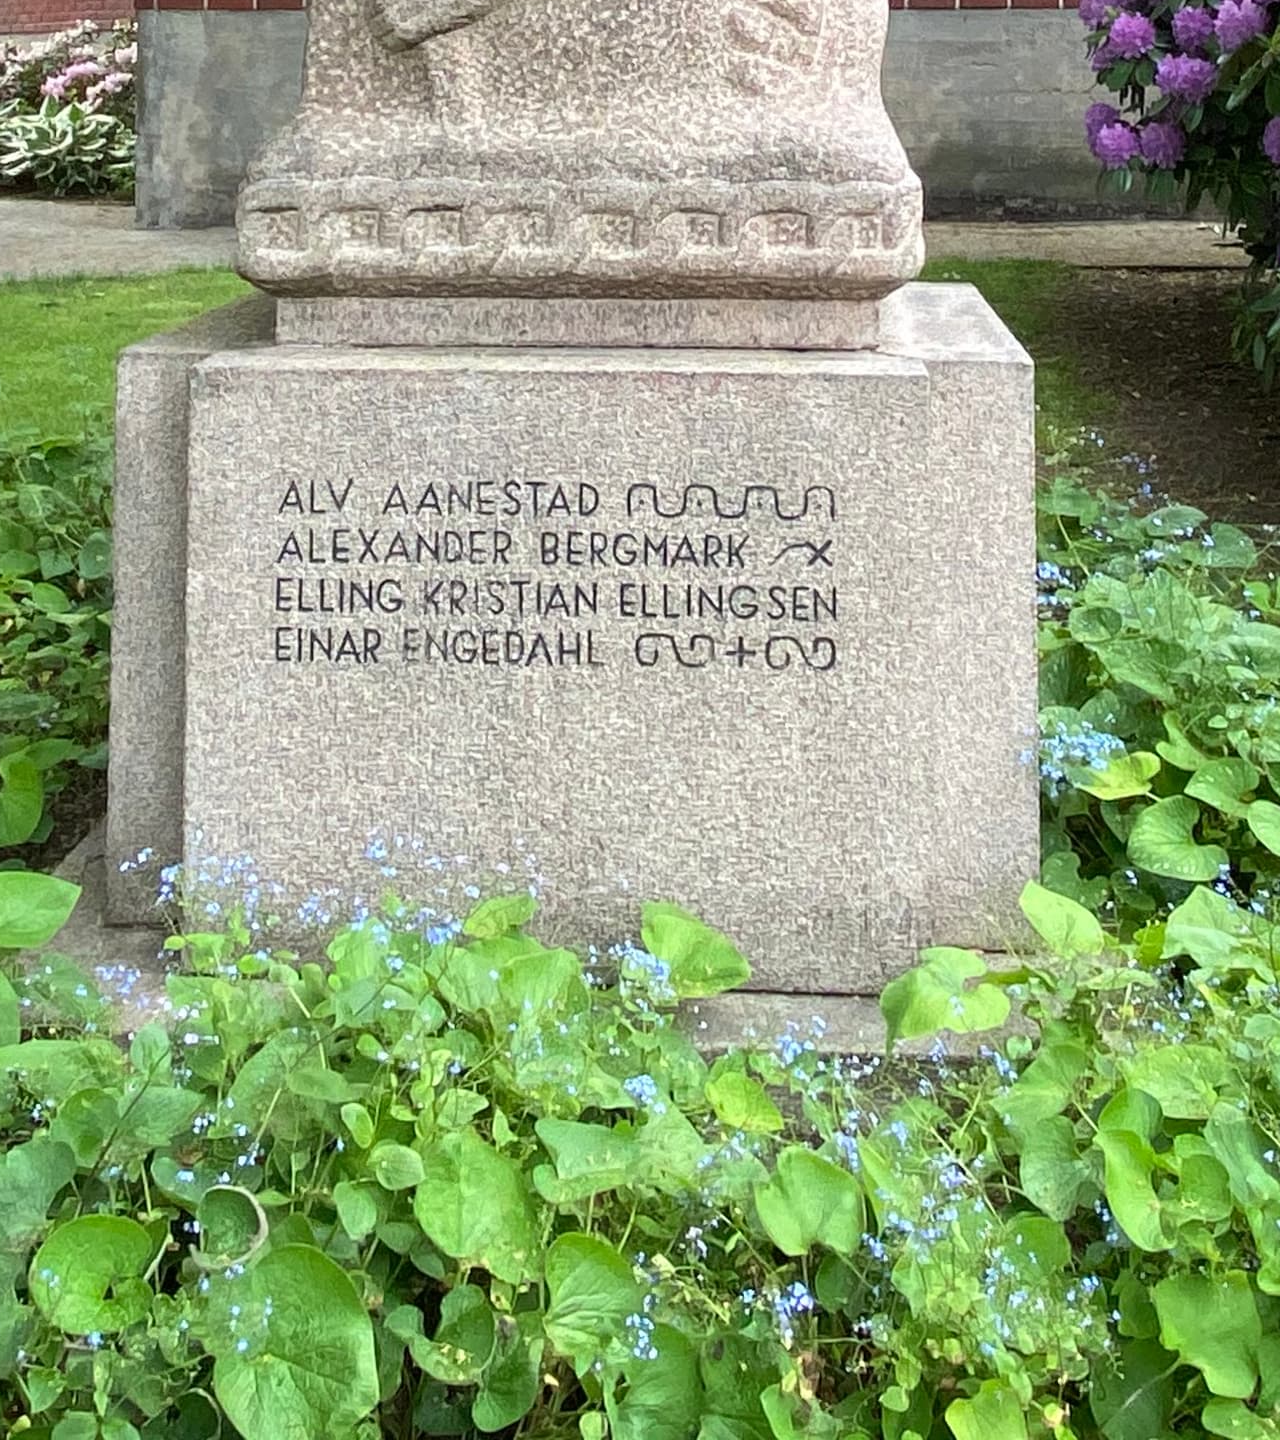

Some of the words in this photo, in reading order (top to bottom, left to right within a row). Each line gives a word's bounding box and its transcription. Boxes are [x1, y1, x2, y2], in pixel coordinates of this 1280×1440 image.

[278, 479, 354, 516] ALV
[383, 482, 599, 517] AANESTAD
[277, 530, 512, 563] ALEXANDER
[541, 532, 749, 568] BERGMARK
[276, 578, 402, 613] ELLING
[423, 579, 598, 616] KRISTIAN
[620, 584, 838, 621] ELLINGSEN
[275, 628, 382, 663] EINAR
[404, 629, 603, 666] ENGEDAHL
